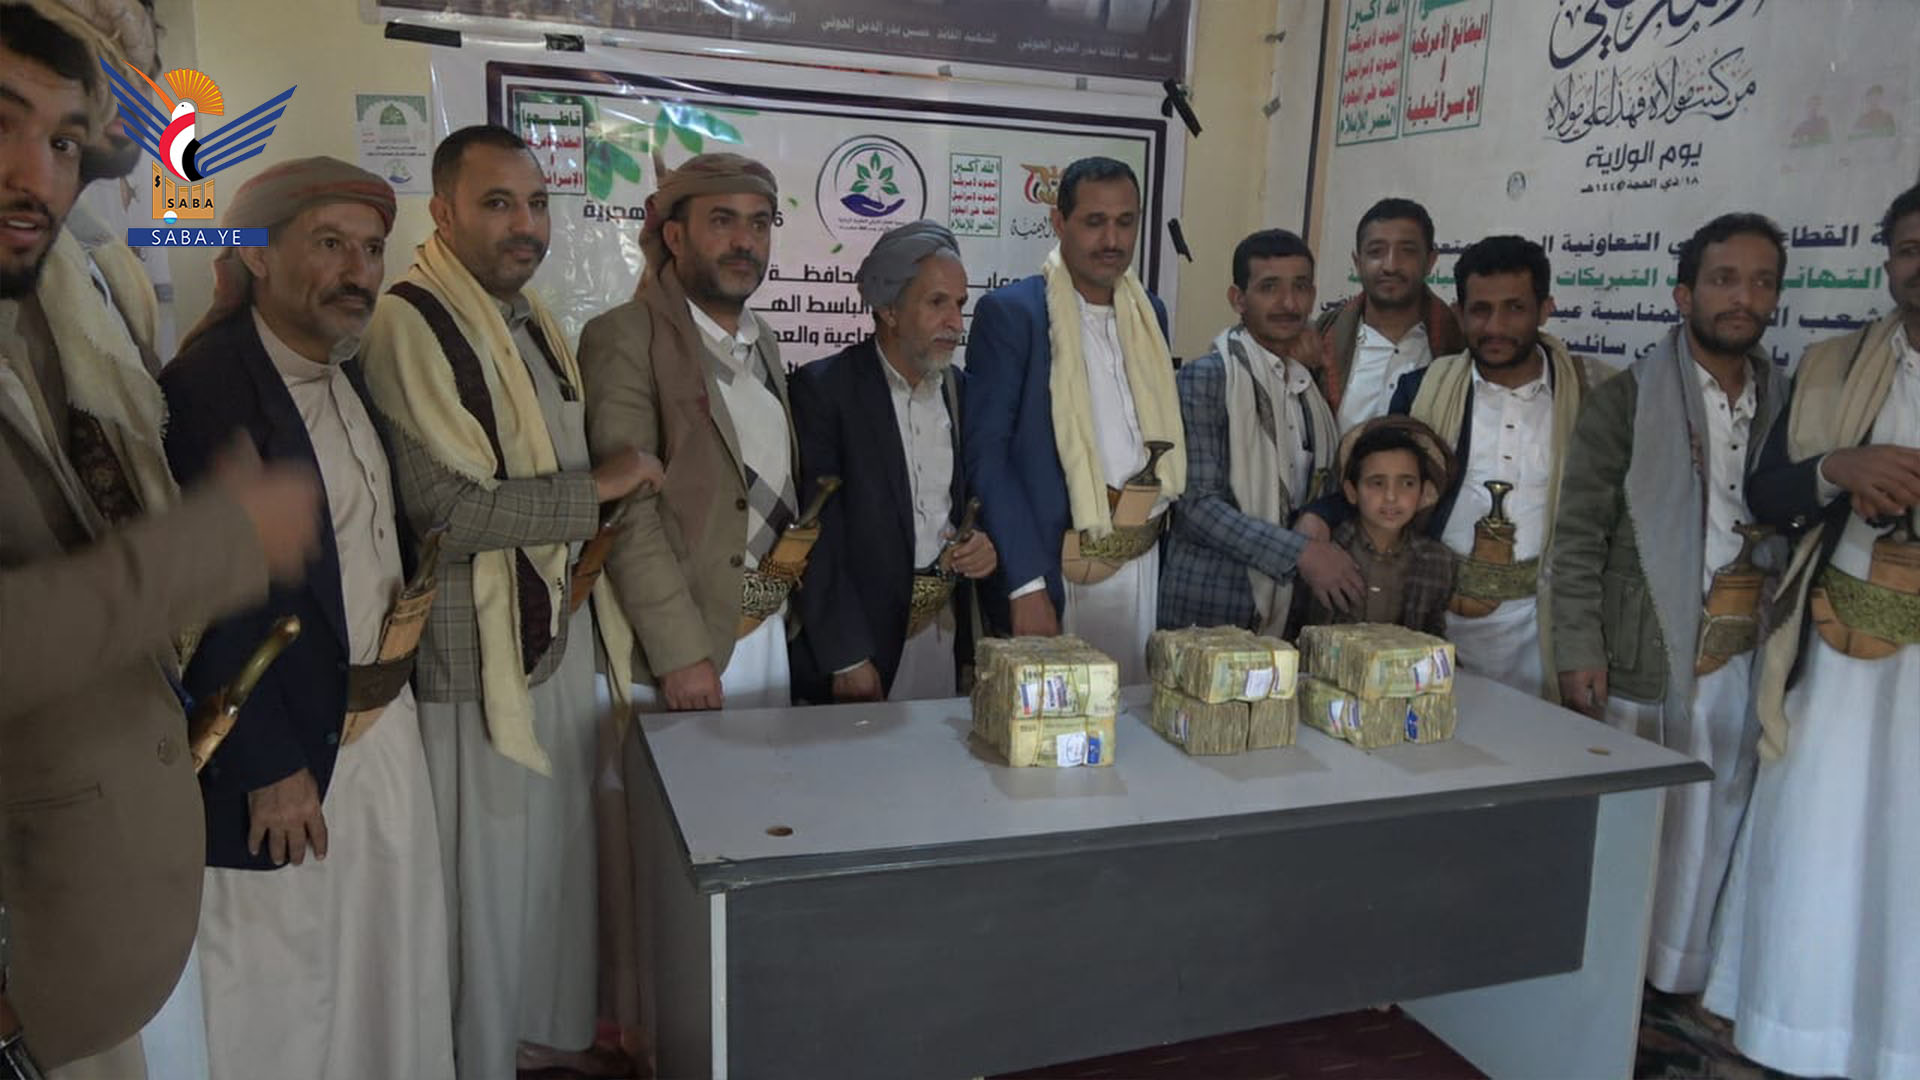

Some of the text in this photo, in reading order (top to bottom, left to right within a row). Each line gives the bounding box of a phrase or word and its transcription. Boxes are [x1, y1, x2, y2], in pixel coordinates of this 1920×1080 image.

[1585, 141, 1702, 175] يوم الولاية
[583, 199, 645, 224] هجرية
[1561, 231, 1660, 257] التعاونية
[769, 264, 858, 284] حافظة
[1556, 267, 1658, 291] التبريكات
